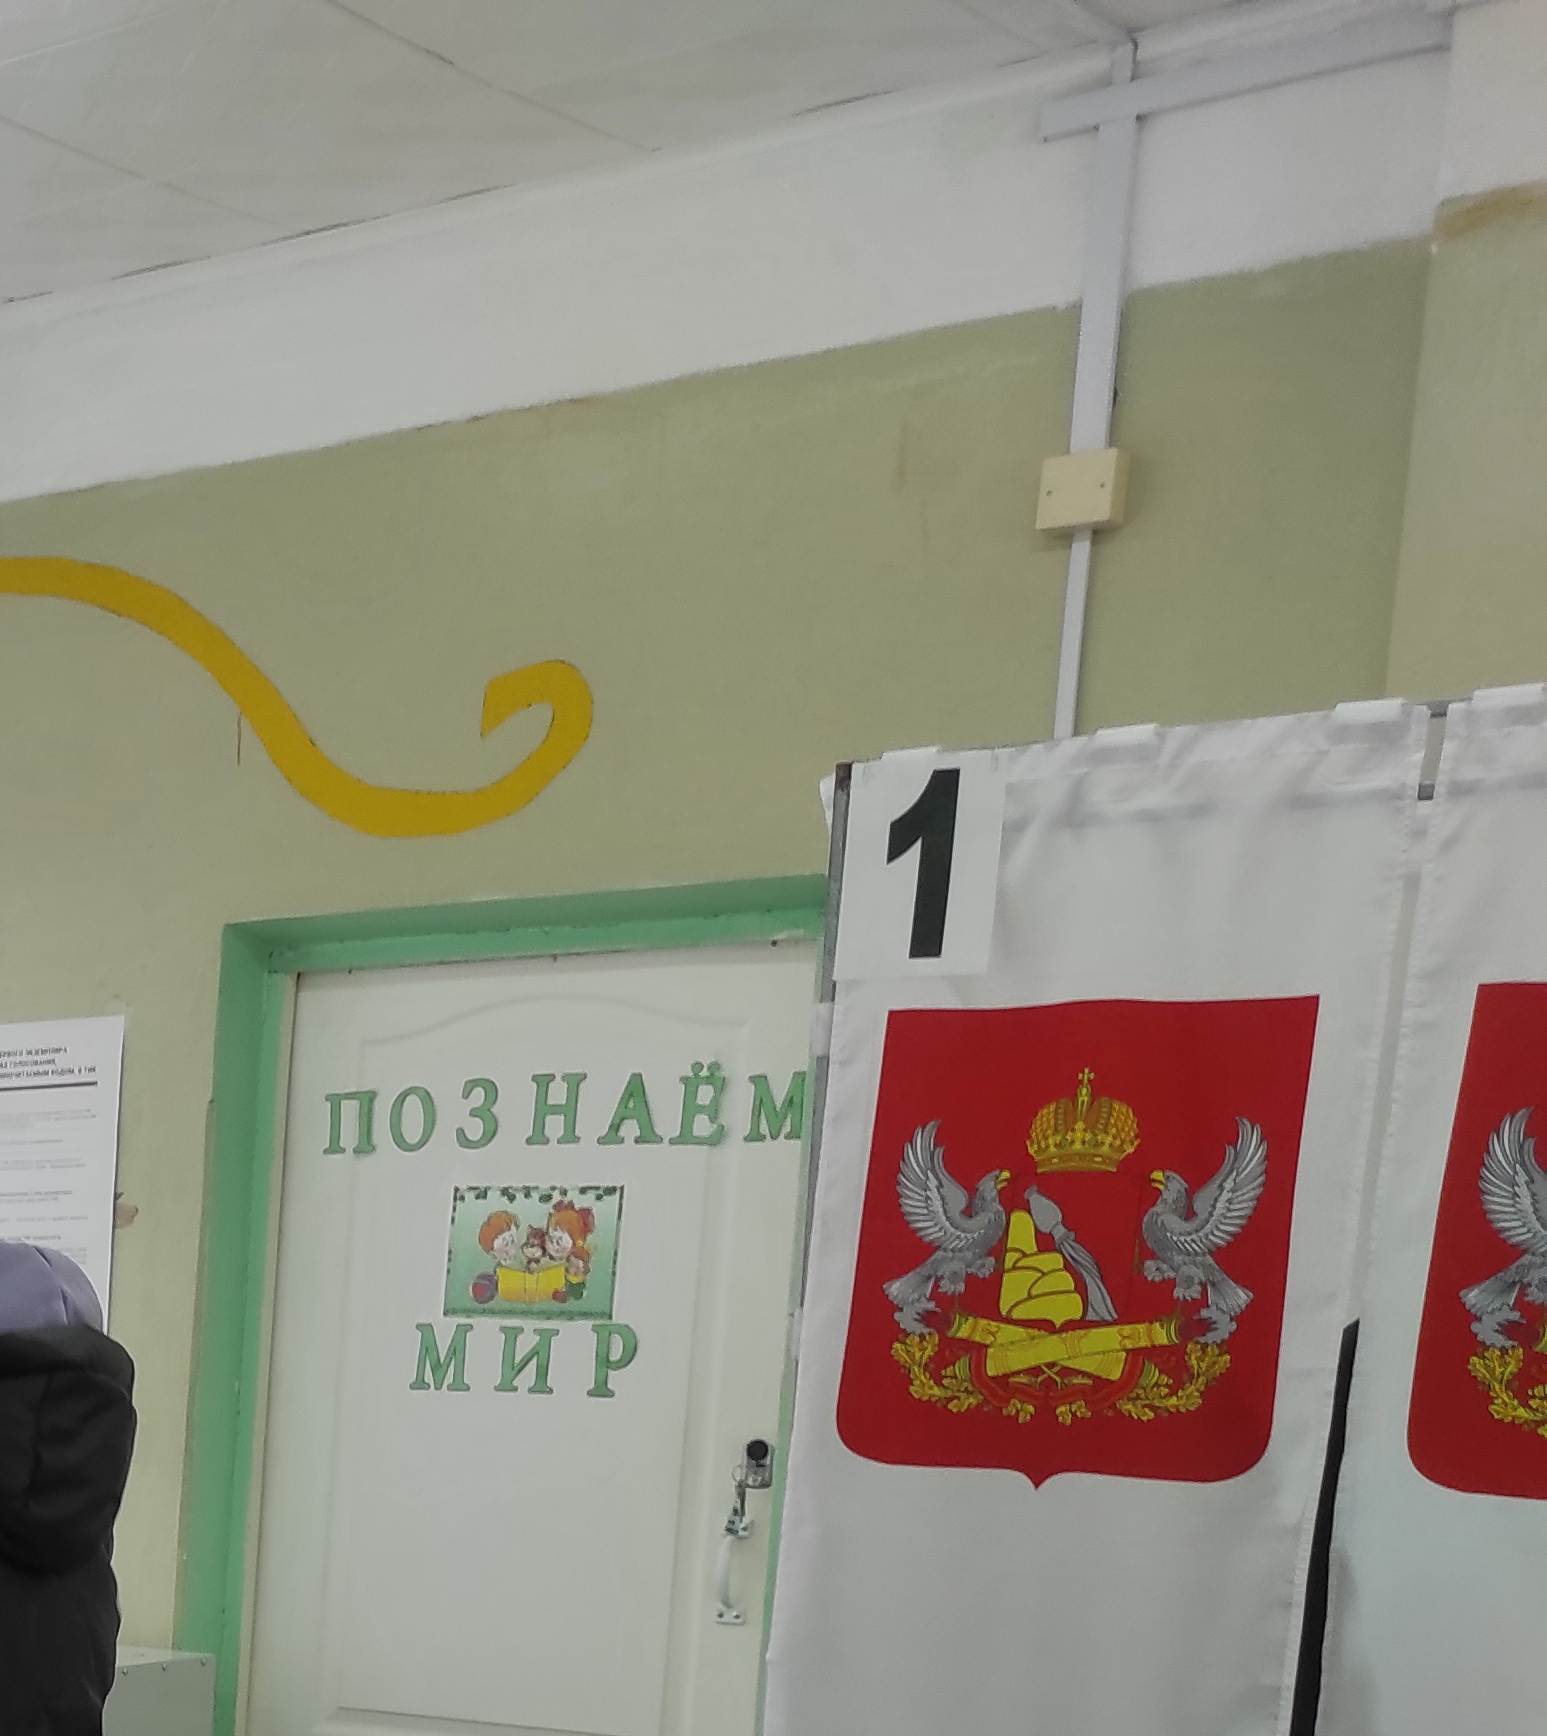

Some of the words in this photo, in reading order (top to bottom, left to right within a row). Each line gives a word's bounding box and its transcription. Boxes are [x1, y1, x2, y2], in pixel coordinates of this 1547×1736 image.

[886, 768, 960, 959] 1
[323, 1061, 806, 1155] ПОЗНАЁМ
[409, 1323, 640, 1398] МИР
